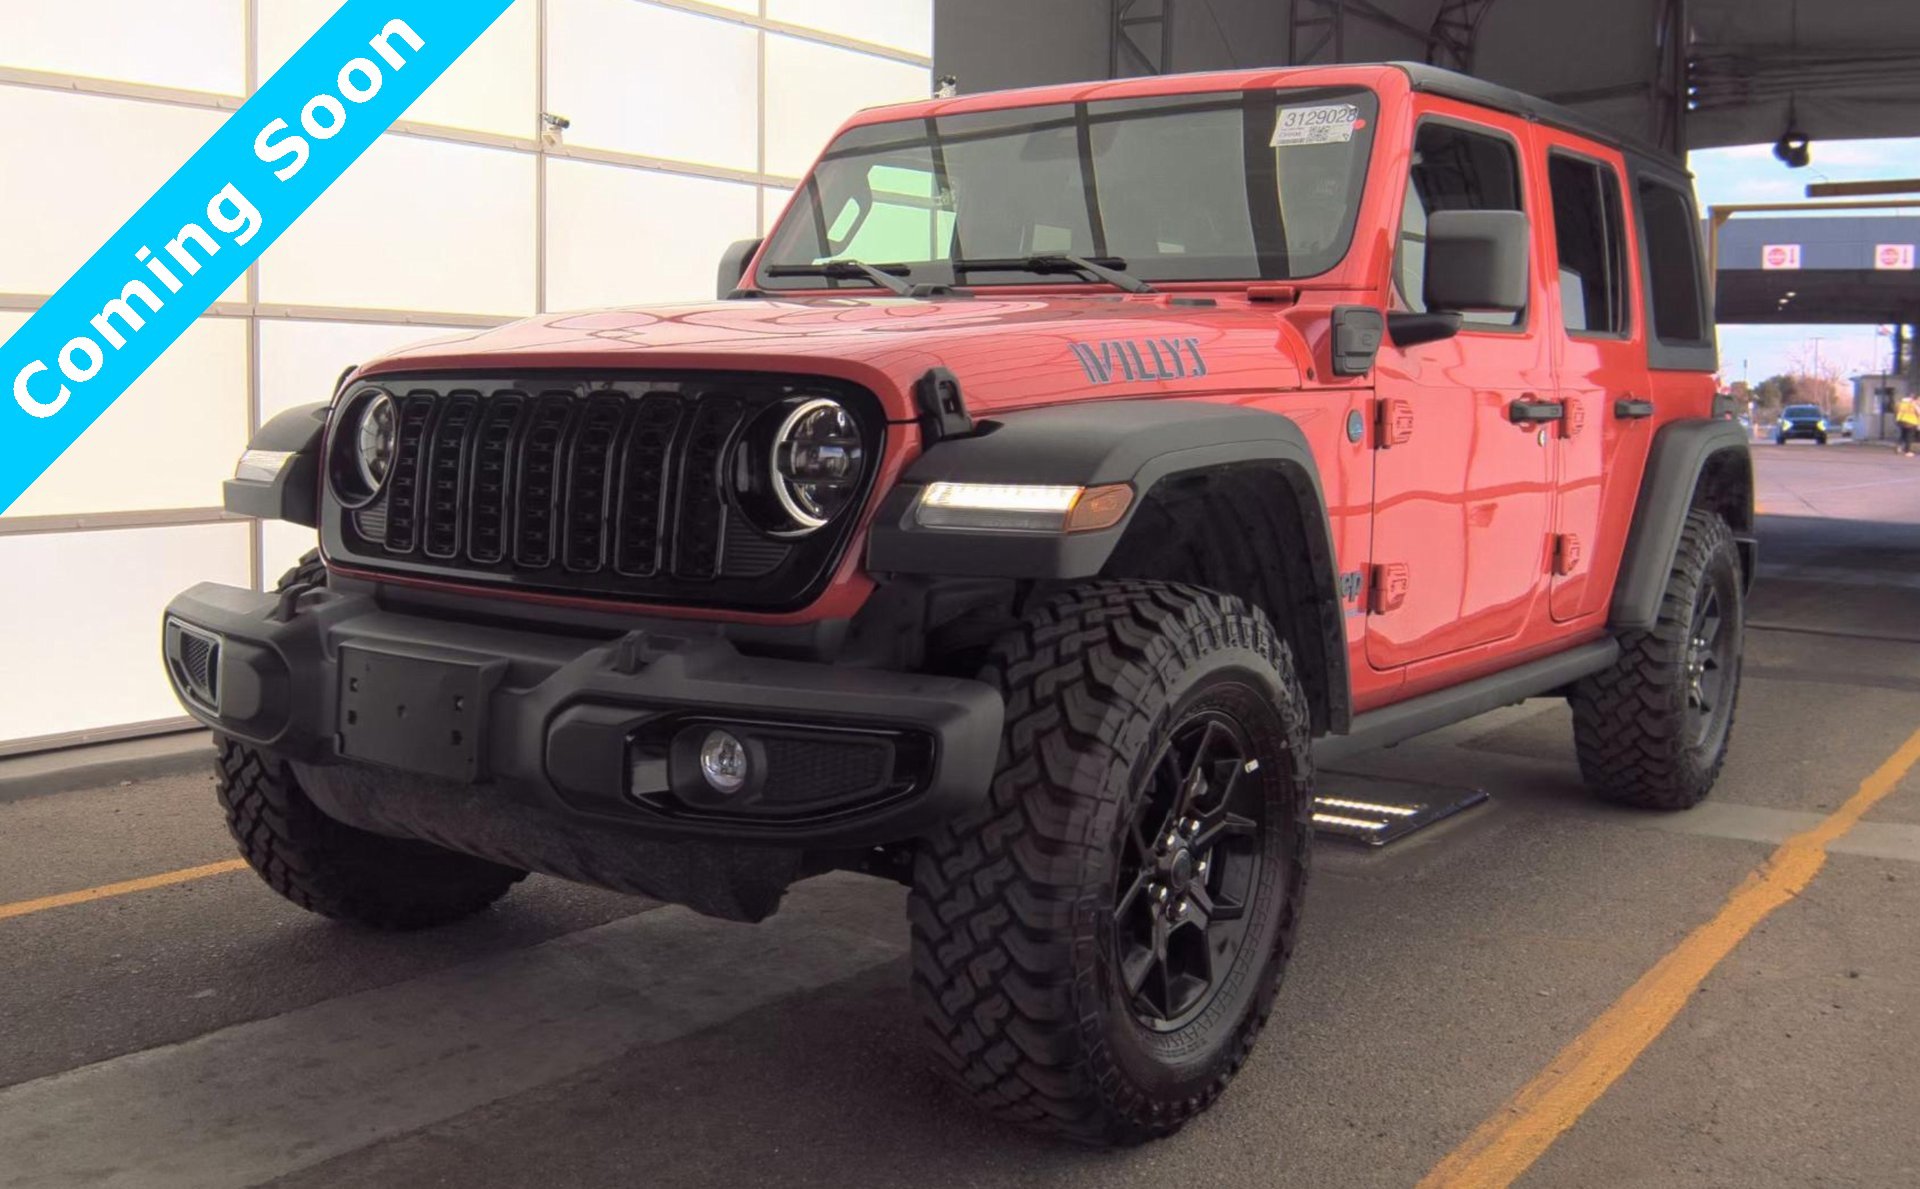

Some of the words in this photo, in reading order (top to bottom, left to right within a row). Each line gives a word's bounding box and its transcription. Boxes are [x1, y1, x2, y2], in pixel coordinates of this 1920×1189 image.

[1284, 109, 1358, 127] 3129028
[1067, 336, 1208, 384] WILLYS
[1341, 572, 1362, 602] ep
